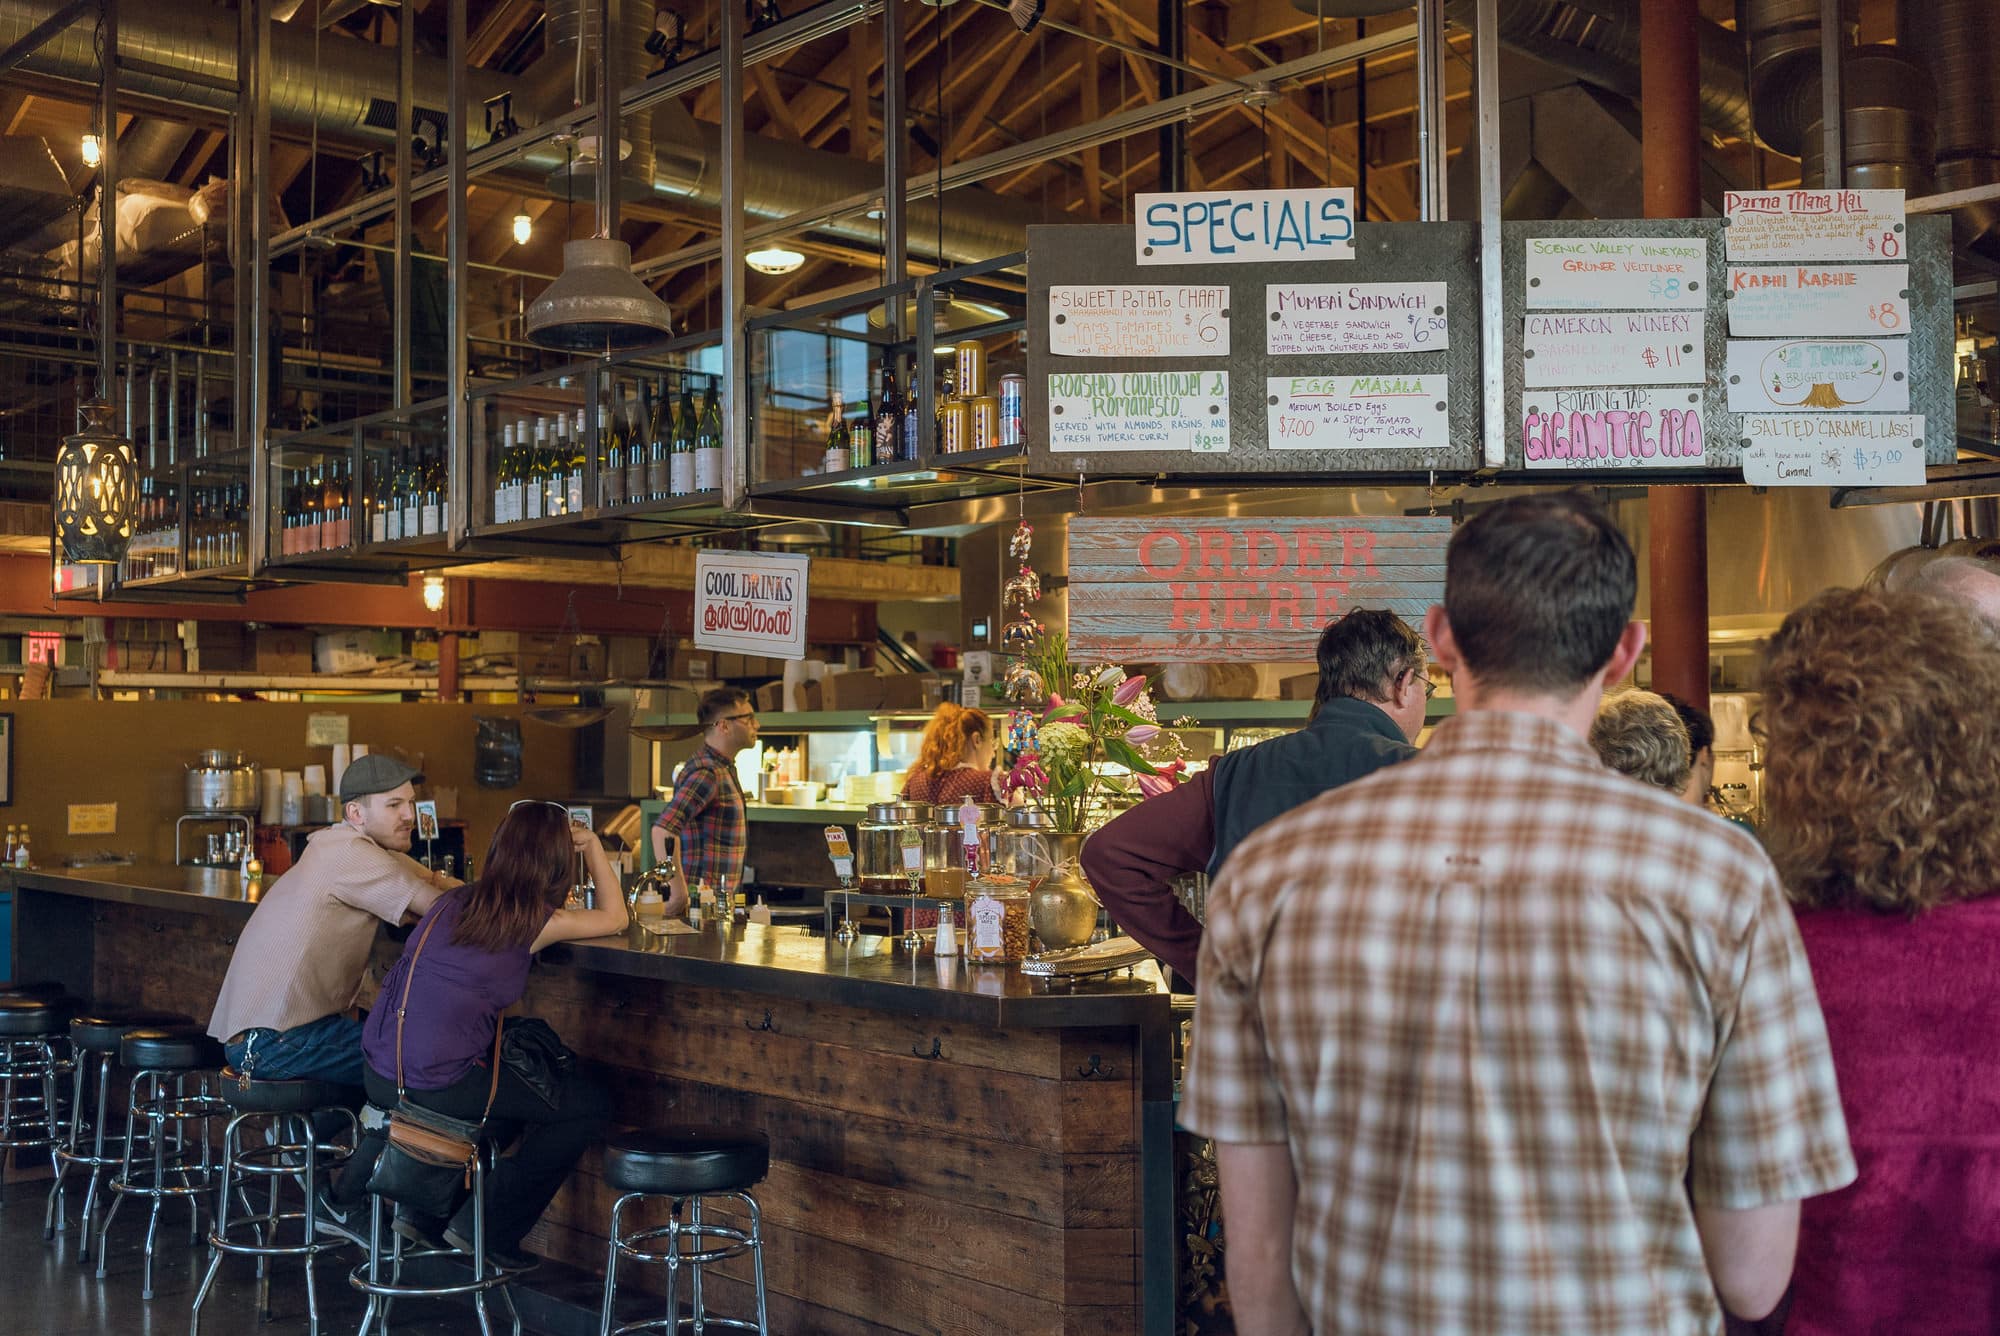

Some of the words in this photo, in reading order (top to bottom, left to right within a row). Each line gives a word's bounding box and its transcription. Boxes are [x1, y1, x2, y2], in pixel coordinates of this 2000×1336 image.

[1787, 191, 1832, 211] Mana
[1833, 191, 1863, 213] Hai
[1146, 198, 1353, 254] SPECIALS
[1590, 242, 1634, 255] VALLEY
[1641, 245, 1702, 259] VINEYARD
[1648, 274, 1680, 300] $8
[1179, 288, 1225, 309] CHAAT
[1281, 320, 1288, 329] A
[1530, 316, 1612, 336] CAMERON
[1627, 315, 1691, 334] WINERY
[1385, 332, 1404, 340] AND
[1373, 343, 1389, 351] AND
[1641, 344, 1681, 369] $11
[1326, 402, 1362, 412] BOILED
[1556, 391, 1620, 412] ROTATING
[1054, 421, 1089, 432] SERVED
[1095, 421, 1116, 431] WITH
[1210, 417, 1227, 429] AND
[1342, 414, 1370, 425] SPICY
[1751, 418, 1815, 438] SALTED
[1818, 419, 1878, 440] CARAMEL
[1064, 433, 1091, 443] FRESH
[1138, 431, 1170, 441] CURRY
[1777, 460, 1813, 479] Caramel
[1138, 527, 1379, 579] ORDER
[705, 571, 739, 598] COOL
[741, 573, 793, 602] DRINKS
